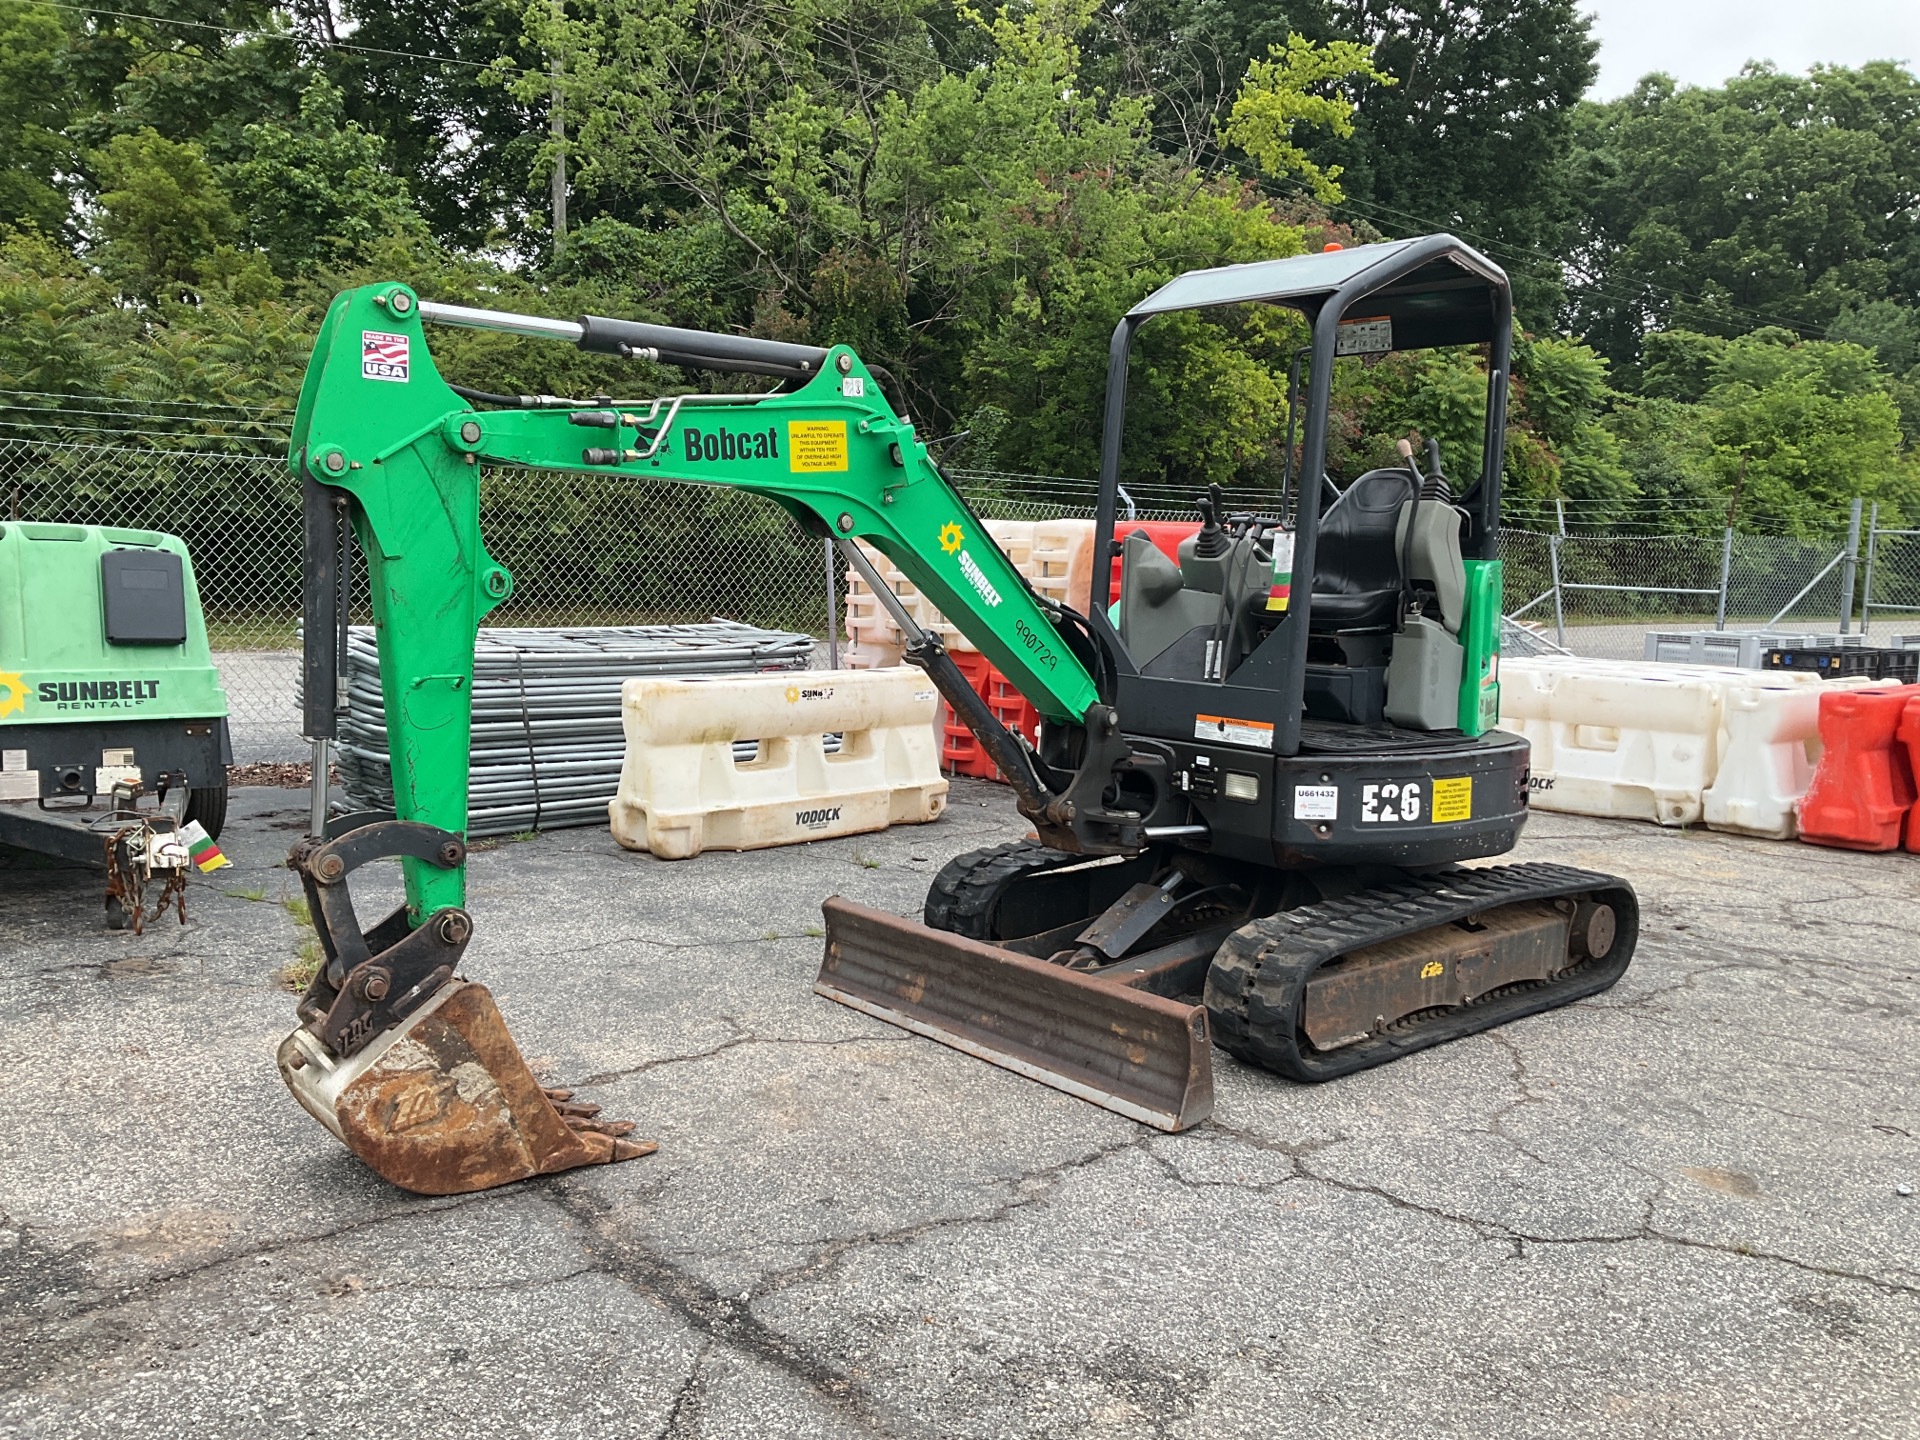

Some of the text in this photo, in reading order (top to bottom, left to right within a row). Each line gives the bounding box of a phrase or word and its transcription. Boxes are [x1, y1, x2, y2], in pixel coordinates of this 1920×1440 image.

[365, 333, 384, 341] MADE
[366, 362, 405, 377] USA
[683, 427, 779, 462] Bobcat
[957, 549, 1003, 608] SUNBELT
[959, 566, 991, 606] RENTALS
[1014, 619, 1059, 672] 990729
[38, 680, 160, 702] SUNBELT
[1225, 718, 1249, 727] WARNING
[1530, 776, 1555, 789] OCK
[1362, 783, 1420, 822] E26
[796, 807, 841, 825] YODOCK
